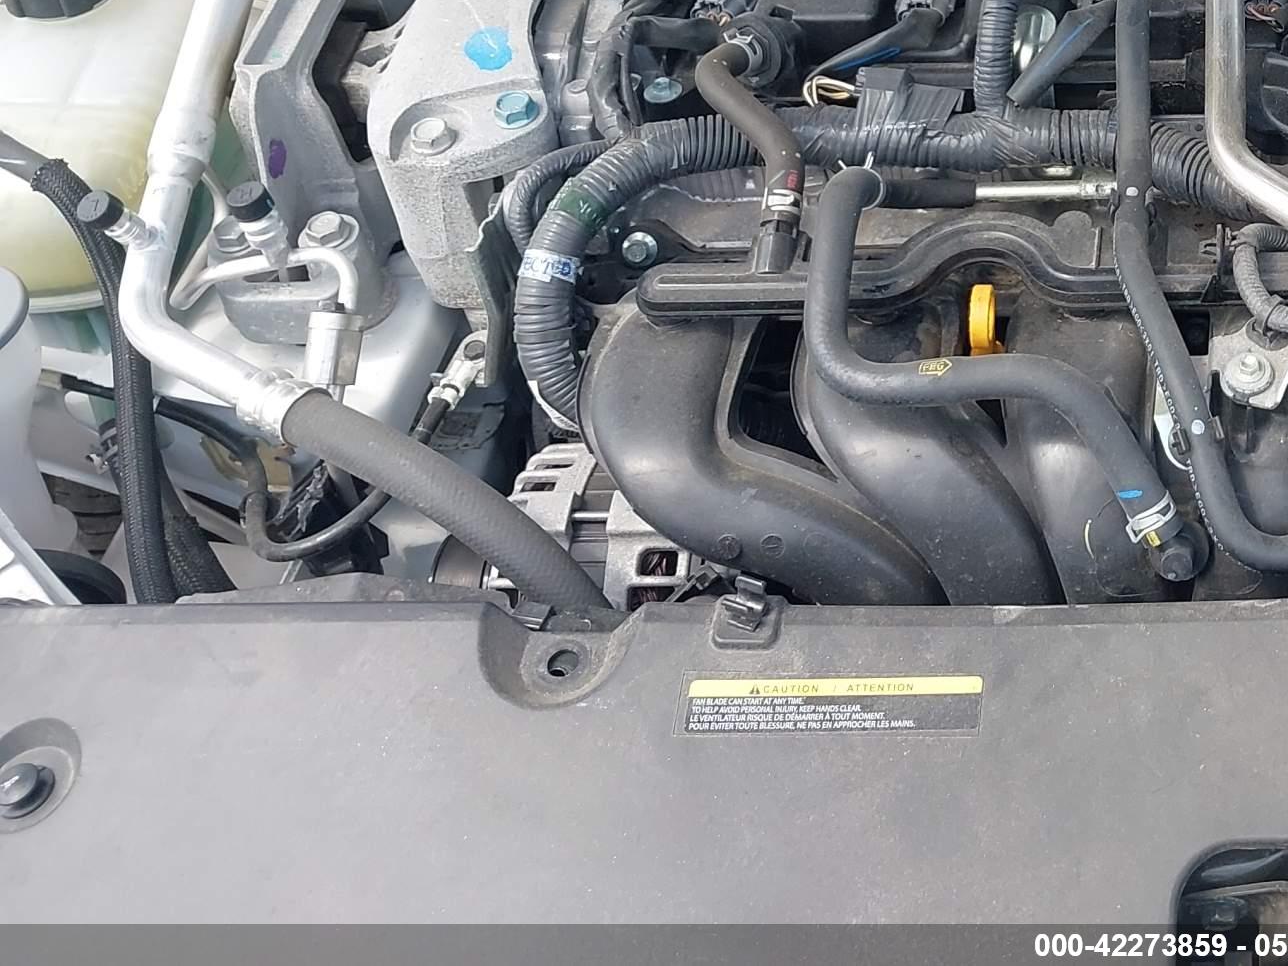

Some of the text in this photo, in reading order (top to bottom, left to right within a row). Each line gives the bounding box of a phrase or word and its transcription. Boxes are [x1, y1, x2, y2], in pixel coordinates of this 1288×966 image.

[763, 684, 819, 694] CAUTION
[846, 683, 915, 693] ATTENTION
[692, 697, 706, 706] FAN
[706, 697, 727, 706] BLADE
[728, 697, 742, 706] CAN
[743, 697, 763, 706] START
[763, 697, 774, 705] AT
[773, 697, 787, 705] ANY
[691, 706, 701, 714] TO
[701, 706, 718, 714] HELP
[719, 706, 740, 714] AVOID
[740, 706, 775, 714] PERSONAL
[799, 705, 815, 713] KEEP
[815, 705, 839, 713] HANDS
[689, 714, 699, 722] LE
[699, 714, 746, 722] VENTILATEUR
[746, 713, 773, 722] RISQUE
[773, 713, 784, 722] DE
[831, 712, 851, 721] TOUT
[688, 722, 709, 730] POUR
[735, 721, 759, 730] TOUTE
[795, 720, 807, 729] NE
[807, 720, 821, 729] PAS
[821, 720, 833, 729] EN
[832, 719, 877, 729] APPROCHER
[876, 719, 890, 728] LES
